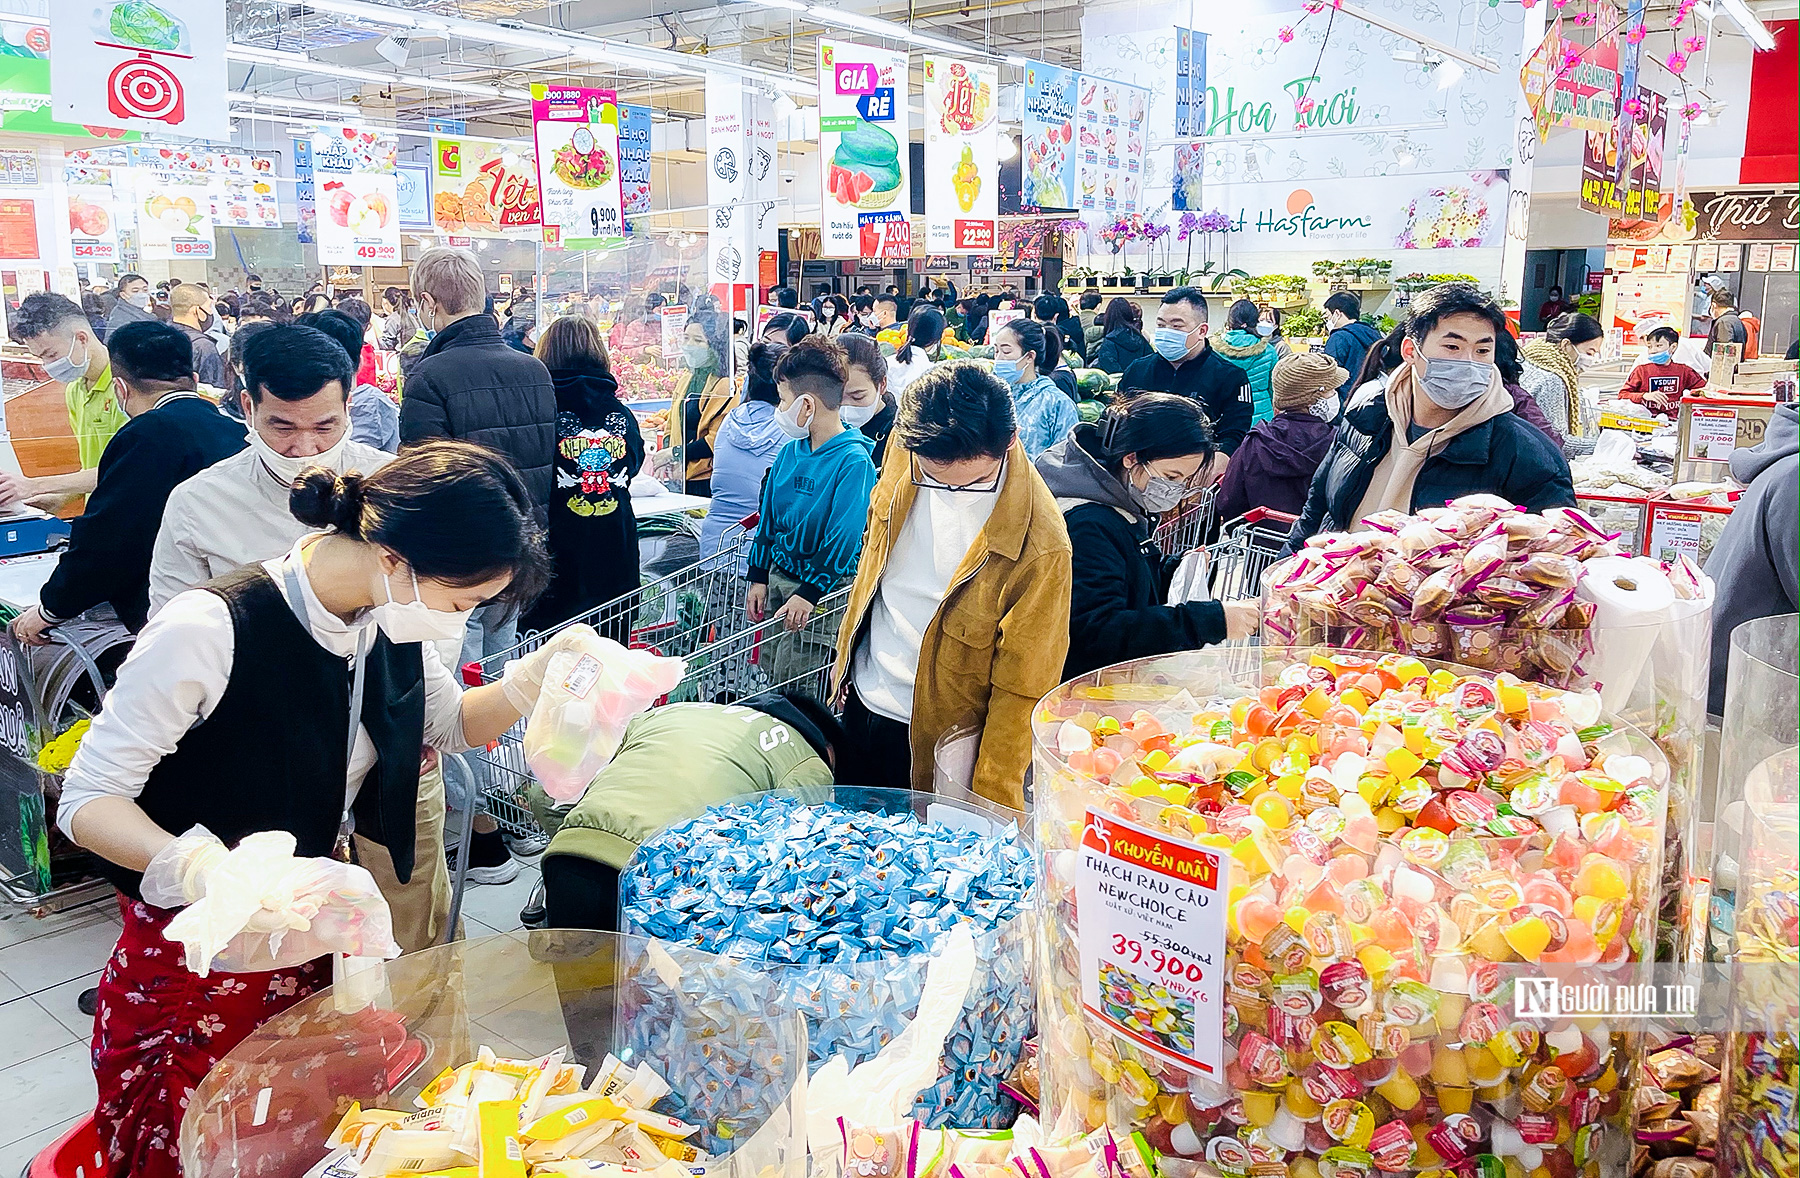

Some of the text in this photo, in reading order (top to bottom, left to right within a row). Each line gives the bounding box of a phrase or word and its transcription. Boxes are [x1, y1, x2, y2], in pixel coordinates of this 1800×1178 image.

[839, 64, 870, 91] GIÁ
[562, 90, 581, 99] 1880
[867, 90, 891, 117] RẺ
[1205, 76, 1361, 140] Hoa Tươi
[620, 145, 651, 167] NHẬP
[874, 215, 884, 223] SO
[884, 213, 902, 222] SÁNH
[1255, 206, 1371, 238] Hasfarm
[1703, 194, 1772, 230] Thịt
[1335, 233, 1354, 241] your
[1355, 231, 1368, 239] life
[75, 245, 113, 256] 54.900
[175, 243, 209, 254] 89.900
[357, 246, 395, 258] 49.900
[1664, 400, 1681, 411] YOR
[1113, 838, 1210, 882] KHUYẾN MÃI
[1085, 855, 1133, 884] THẠCH
[1136, 874, 1170, 895] RAU
[1098, 880, 1188, 922] NEWCHOICE
[1155, 919, 1174, 931] NAM
[1111, 933, 1204, 982] 39.900
[403, 1107, 443, 1124] DURIAN
